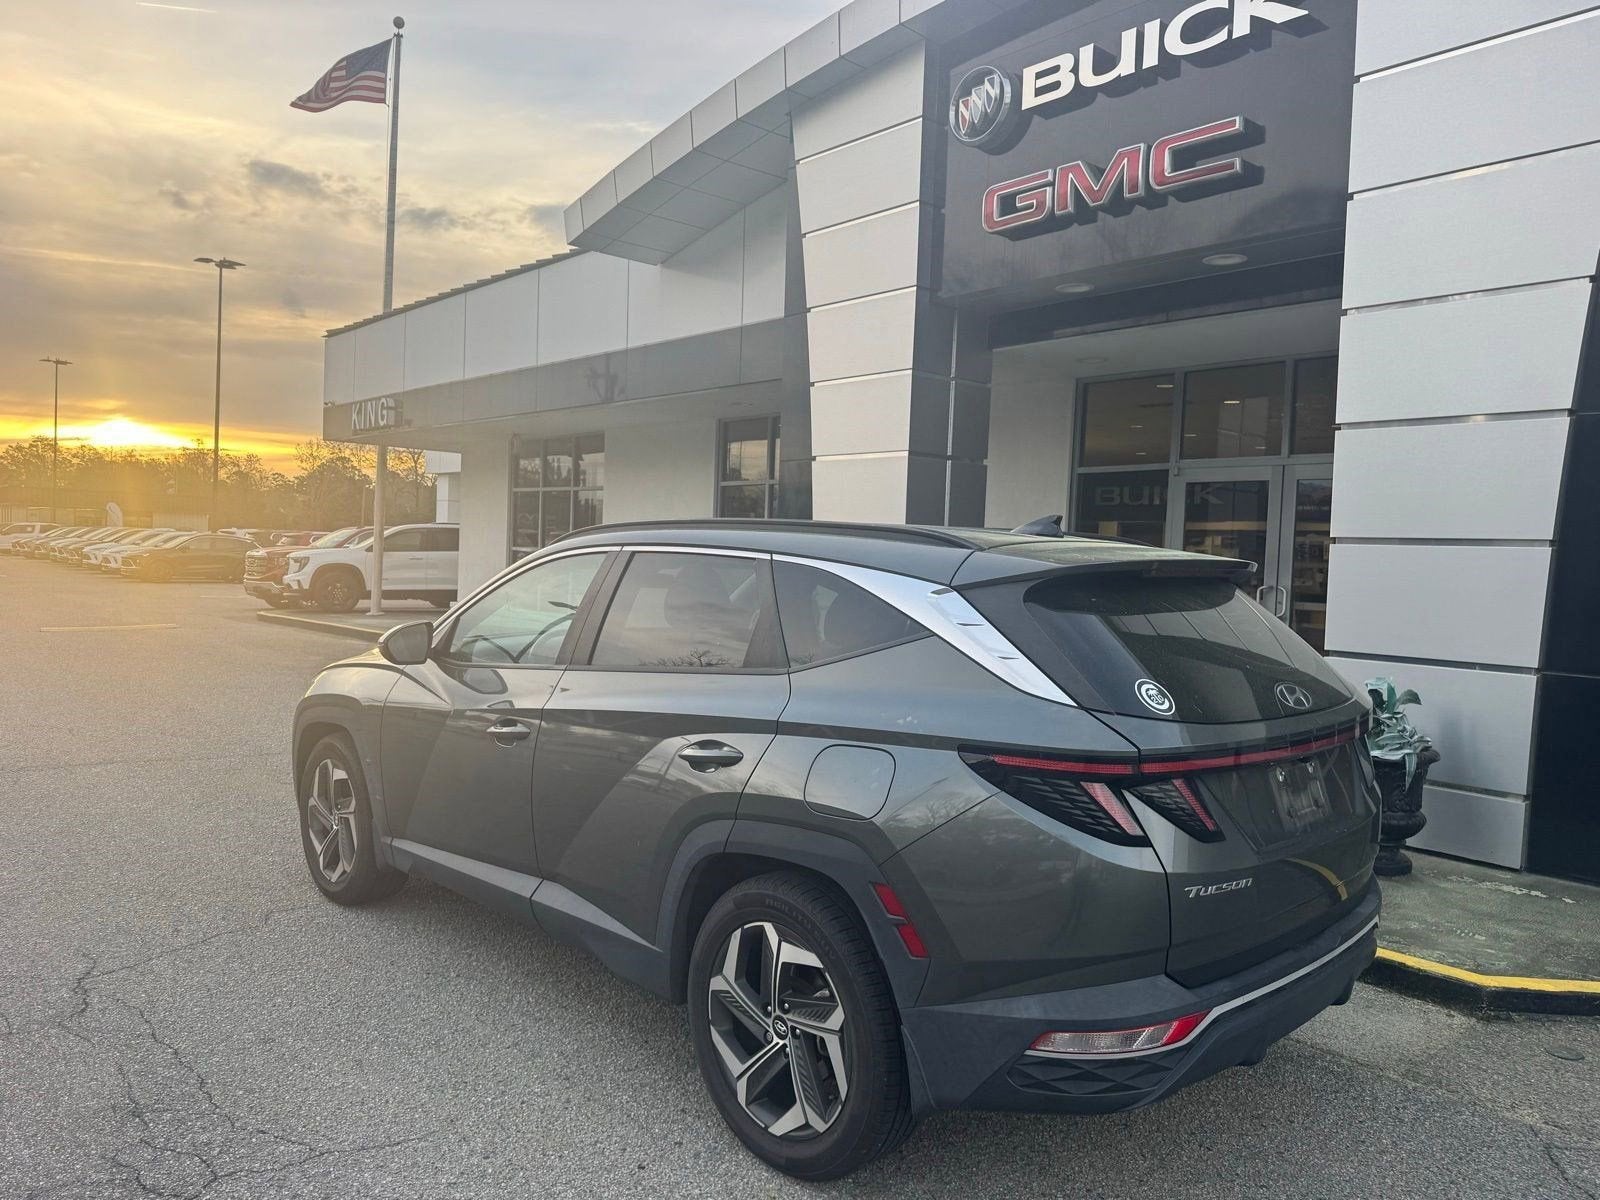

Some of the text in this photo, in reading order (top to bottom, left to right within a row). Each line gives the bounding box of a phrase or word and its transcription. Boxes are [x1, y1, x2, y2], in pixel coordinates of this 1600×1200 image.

[1021, 0, 1309, 111] BUICK
[981, 115, 1245, 235] GMC
[351, 397, 388, 430] KING
[1094, 483, 1227, 506] BUIK
